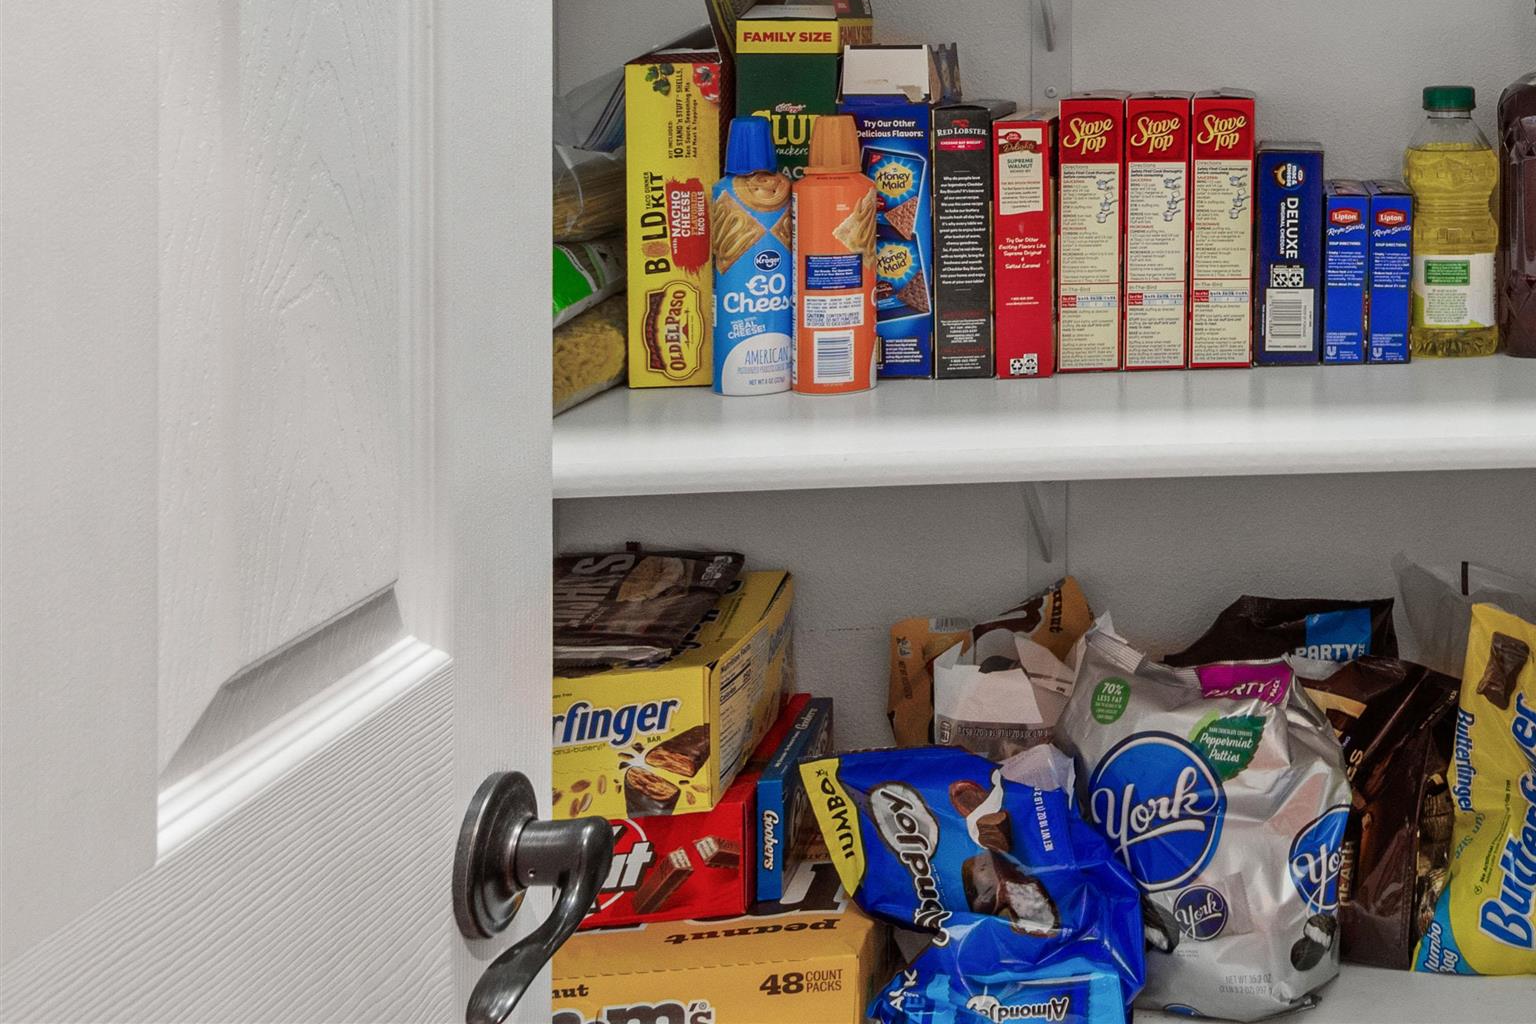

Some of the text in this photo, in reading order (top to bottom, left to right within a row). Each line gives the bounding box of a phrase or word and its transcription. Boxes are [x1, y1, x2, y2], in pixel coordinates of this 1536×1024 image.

[743, 31, 833, 43] FAMILY SIZE
[863, 120, 876, 129] Try
[892, 130, 924, 138] Flavors:
[936, 127, 987, 136] RED LOBSTER
[1063, 117, 1114, 148] Stove
[1130, 115, 1181, 147] Stove
[1197, 114, 1248, 145] Stove
[1080, 135, 1107, 155] Top
[1147, 134, 1174, 154] Top
[1214, 132, 1240, 151] Top
[877, 171, 911, 184] Honey
[650, 171, 665, 209] KIT
[697, 191, 705, 217] SHELLS
[671, 190, 681, 238] NACHO
[681, 190, 691, 238] CHEESE
[1333, 212, 1358, 222] Lipton
[1379, 213, 1403, 223] Lipton
[1285, 197, 1299, 259] DELUXE
[755, 254, 781, 268] Kroger
[877, 250, 909, 269] Honey
[883, 259, 907, 273] Maid
[745, 273, 786, 296] GO
[727, 324, 767, 339] CHEESE!
[669, 346, 687, 372] OLD
[744, 347, 791, 365] AMERICAN
[1295, 643, 1358, 662] PARTY
[1100, 682, 1123, 695] 70%
[1096, 694, 1111, 703] LESS
[1199, 732, 1253, 750] Peppermint
[1209, 748, 1240, 763] Patties
[819, 777, 855, 860] JUMBO
[1090, 766, 1219, 874] York
[763, 808, 780, 871] Goobers
[1174, 893, 1223, 941] York
[664, 918, 841, 945] peanut
[759, 971, 805, 996] 48
[805, 968, 844, 982] COUNT
[805, 980, 842, 994] PACKS
[999, 996, 1070, 1022] Almond
